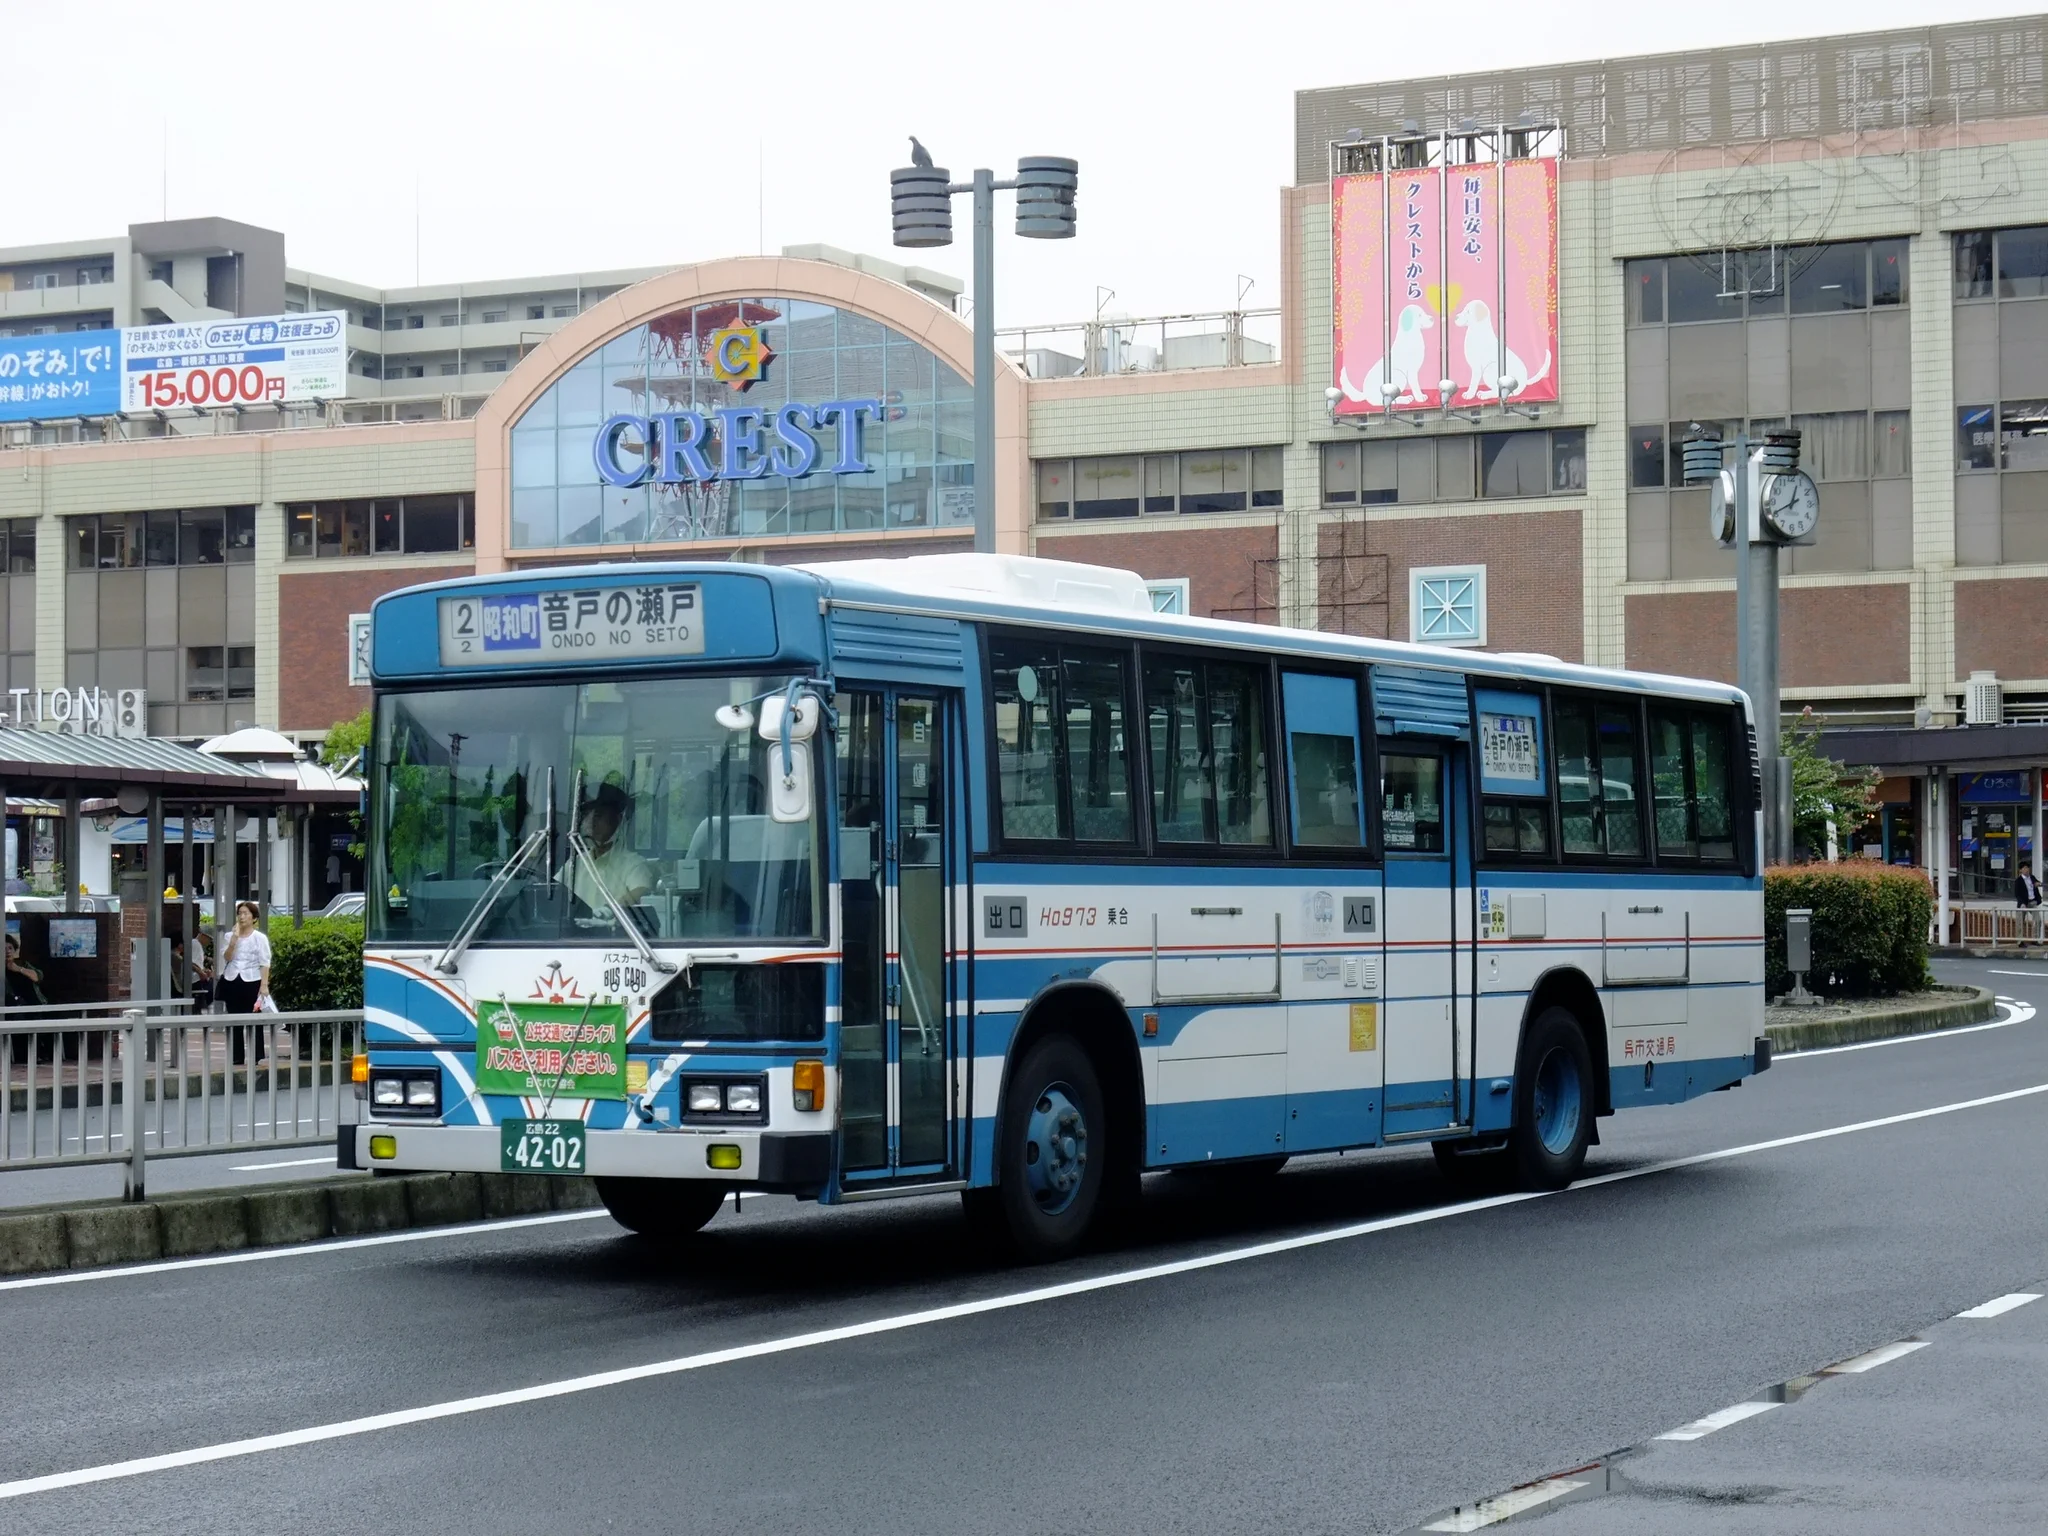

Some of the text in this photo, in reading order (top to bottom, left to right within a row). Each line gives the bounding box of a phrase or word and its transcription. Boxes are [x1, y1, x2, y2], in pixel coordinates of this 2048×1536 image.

[1463, 177, 1482, 263] 毎日安心、
[1406, 182, 1423, 299] クレストから
[718, 333, 751, 374] C
[138, 365, 285, 407] 15,000円
[593, 398, 882, 488] CREST
[457, 603, 473, 634] 2
[483, 603, 538, 641] 昭和町
[543, 584, 697, 632] 音戸の瀬戸
[461, 641, 471, 653] 2
[552, 626, 689, 649] ONDO NO SETO
[9, 686, 99, 723] TION
[1483, 726, 1490, 750] 2
[989, 905, 1022, 928] 出口
[1040, 907, 1097, 926] Ho973
[1108, 907, 1128, 925] 乗合
[1348, 905, 1372, 925] 入口
[604, 967, 646, 993] BUS CARD
[524, 1021, 616, 1043] 公共交通でエコライフ!
[486, 1046, 617, 1076] バスをご利用ください。
[1624, 1036, 1676, 1058] 呉市交通局
[525, 1123, 560, 1135] 広島 22
[506, 1136, 581, 1169] く 42-02
